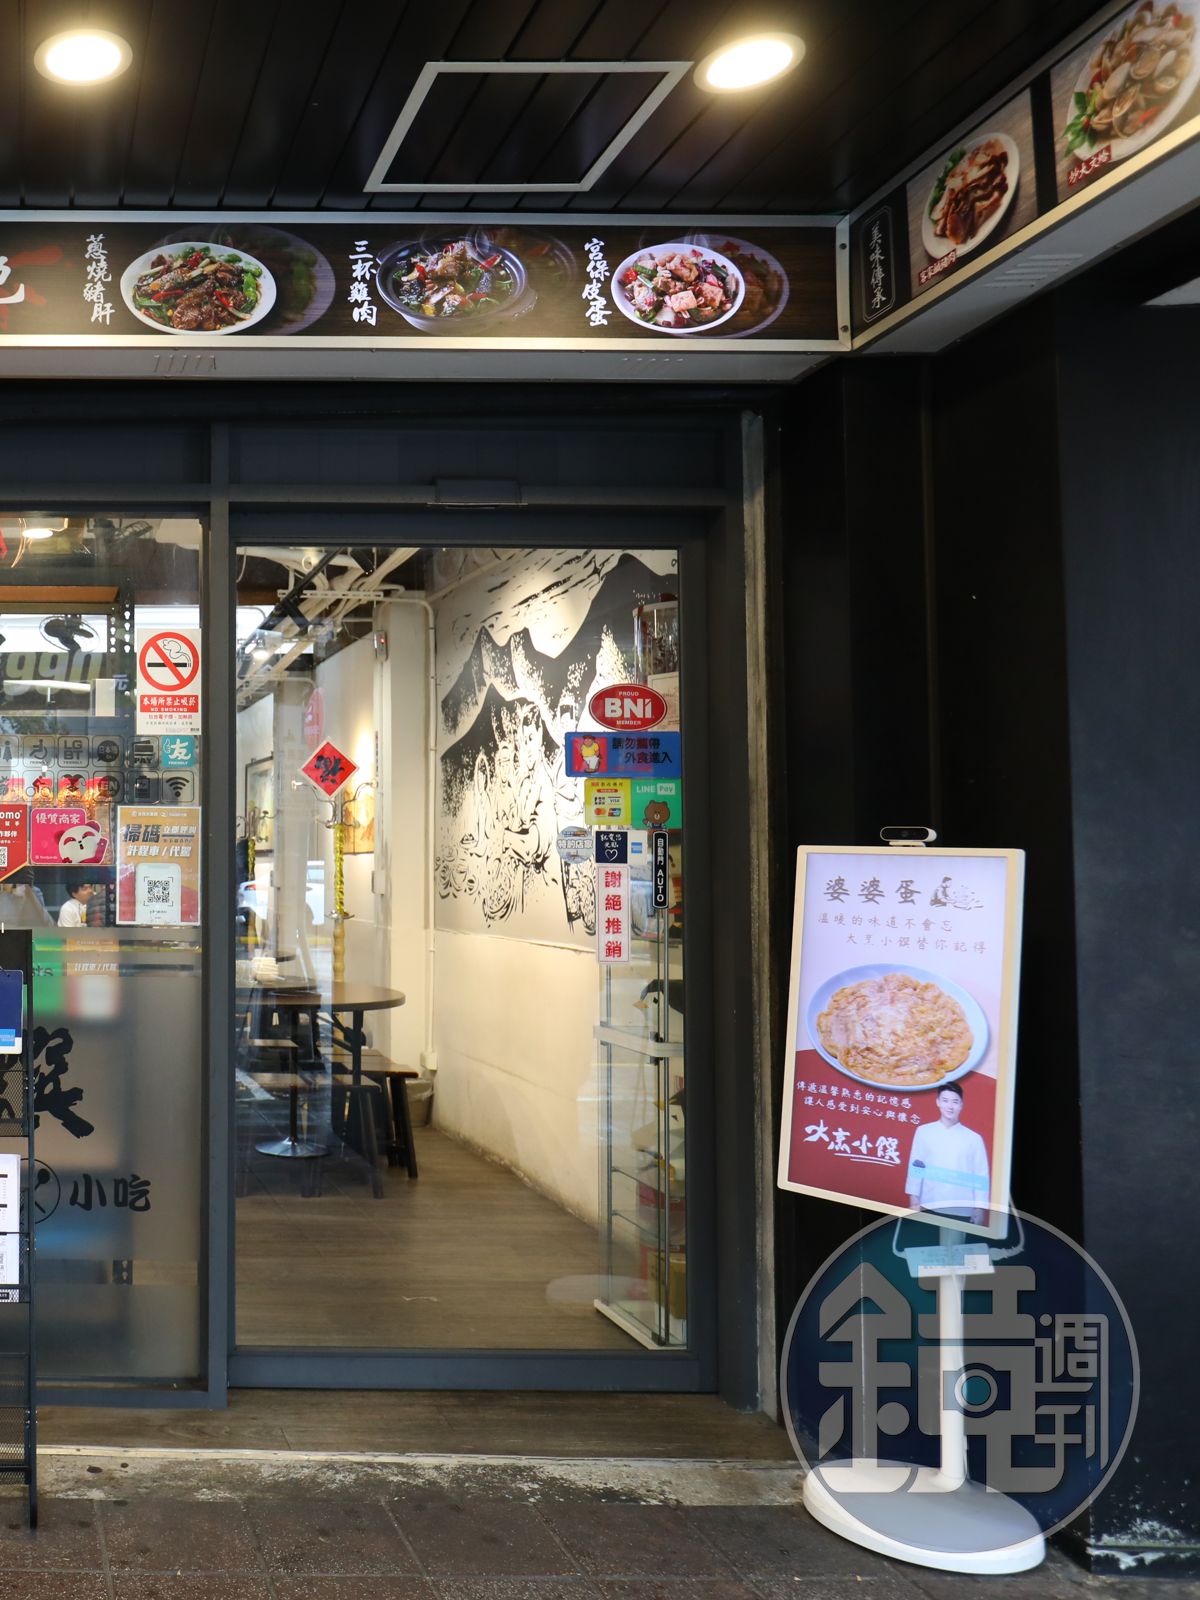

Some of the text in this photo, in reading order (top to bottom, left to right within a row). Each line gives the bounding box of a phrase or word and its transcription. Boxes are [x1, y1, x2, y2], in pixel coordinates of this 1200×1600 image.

[83, 233, 115, 326] 蔥燒豬肝
[347, 240, 379, 327] 三杯雞肉
[581, 238, 612, 327] 宮保皮蛋
[142, 696, 197, 707] 本場所禁止吸菸
[64, 740, 82, 750] LG
[168, 738, 193, 760] 友
[612, 737, 661, 750] 請勿攜帶
[64, 750, 83, 760] BT
[625, 751, 673, 764] 外食進入
[636, 785, 656, 793] LINE
[35, 812, 81, 825] 優質商家
[124, 823, 161, 843] 掃碼
[557, 839, 593, 849] 特約店家
[656, 869, 664, 902] AUTO
[823, 875, 921, 905] 婆婆蛋
[604, 870, 622, 958] 謝絕推銷
[818, 913, 953, 932] 溫暖的味道不會忘
[803, 1119, 901, 1165] 大烹小饌
[69, 1173, 152, 1213] 小吃
